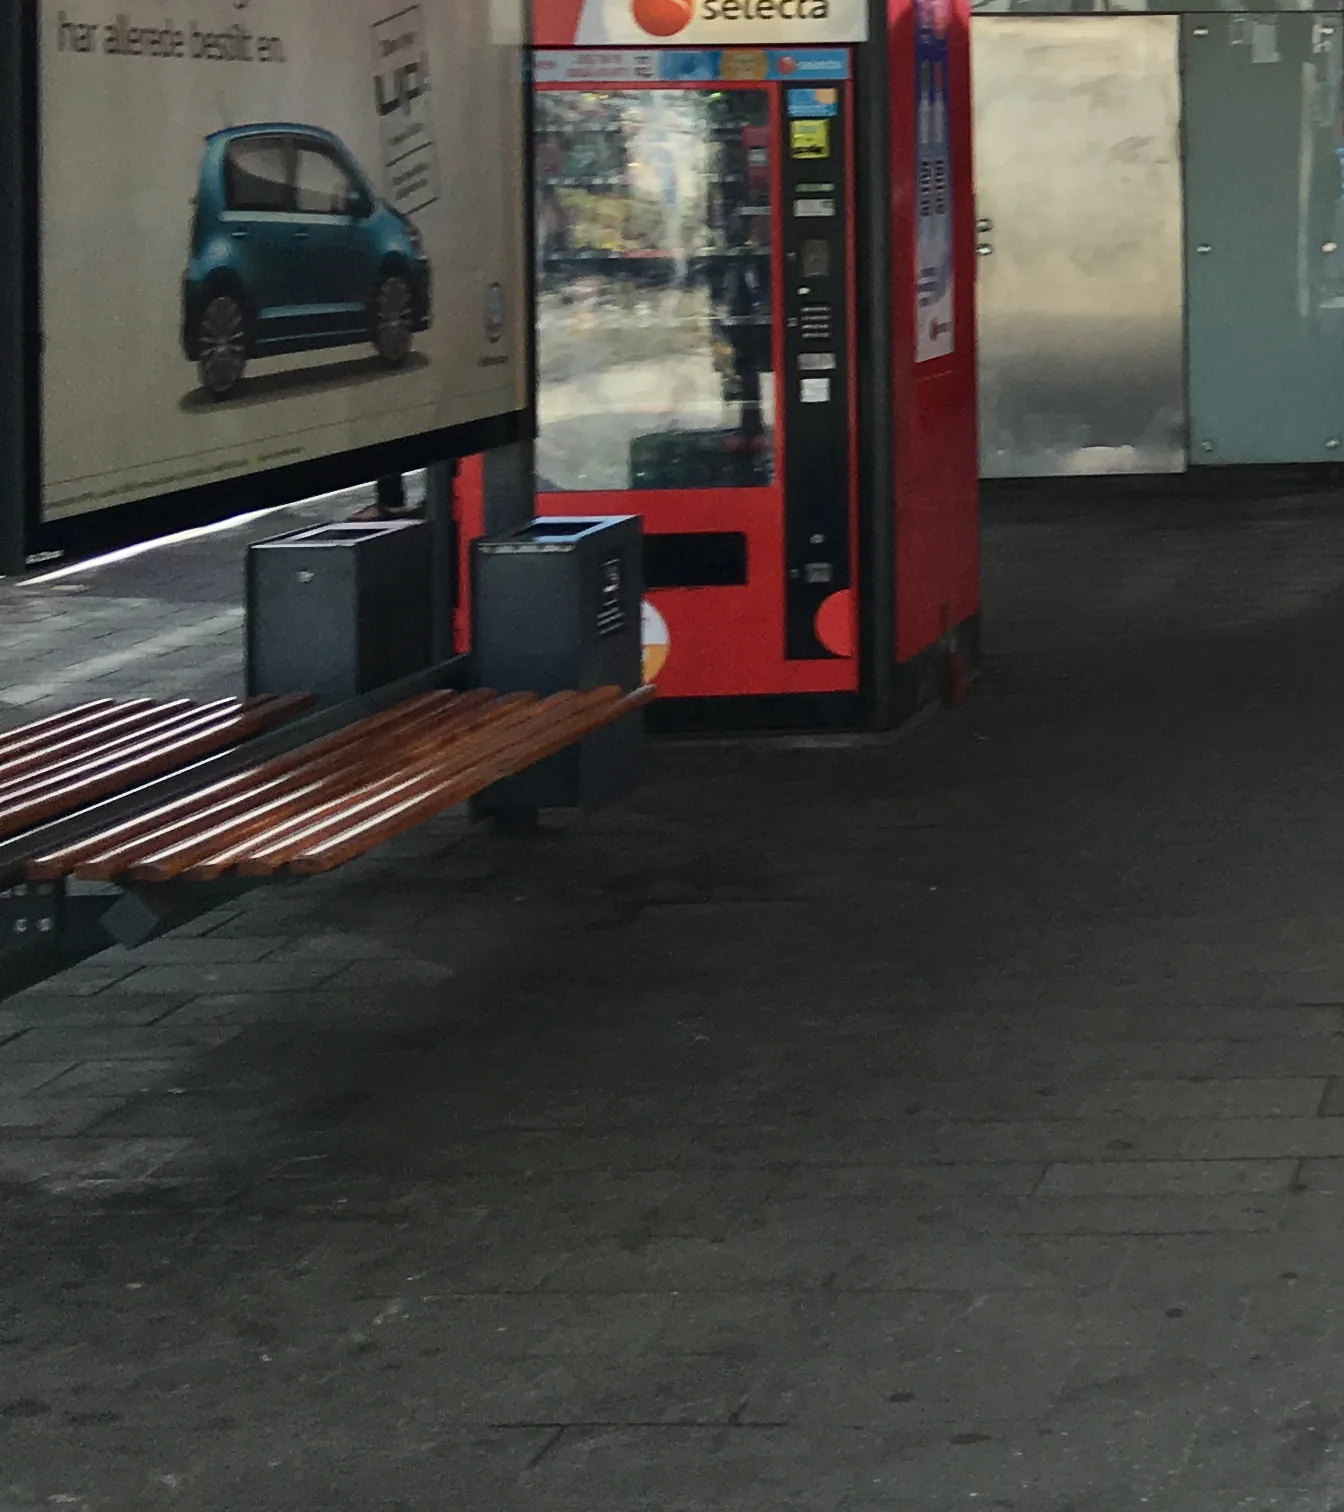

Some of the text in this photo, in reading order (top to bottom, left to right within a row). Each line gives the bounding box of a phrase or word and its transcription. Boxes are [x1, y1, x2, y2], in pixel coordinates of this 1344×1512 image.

[56, 9, 98, 53] har
[102, 13, 184, 58] allerede
[187, 17, 253, 62] bestilt
